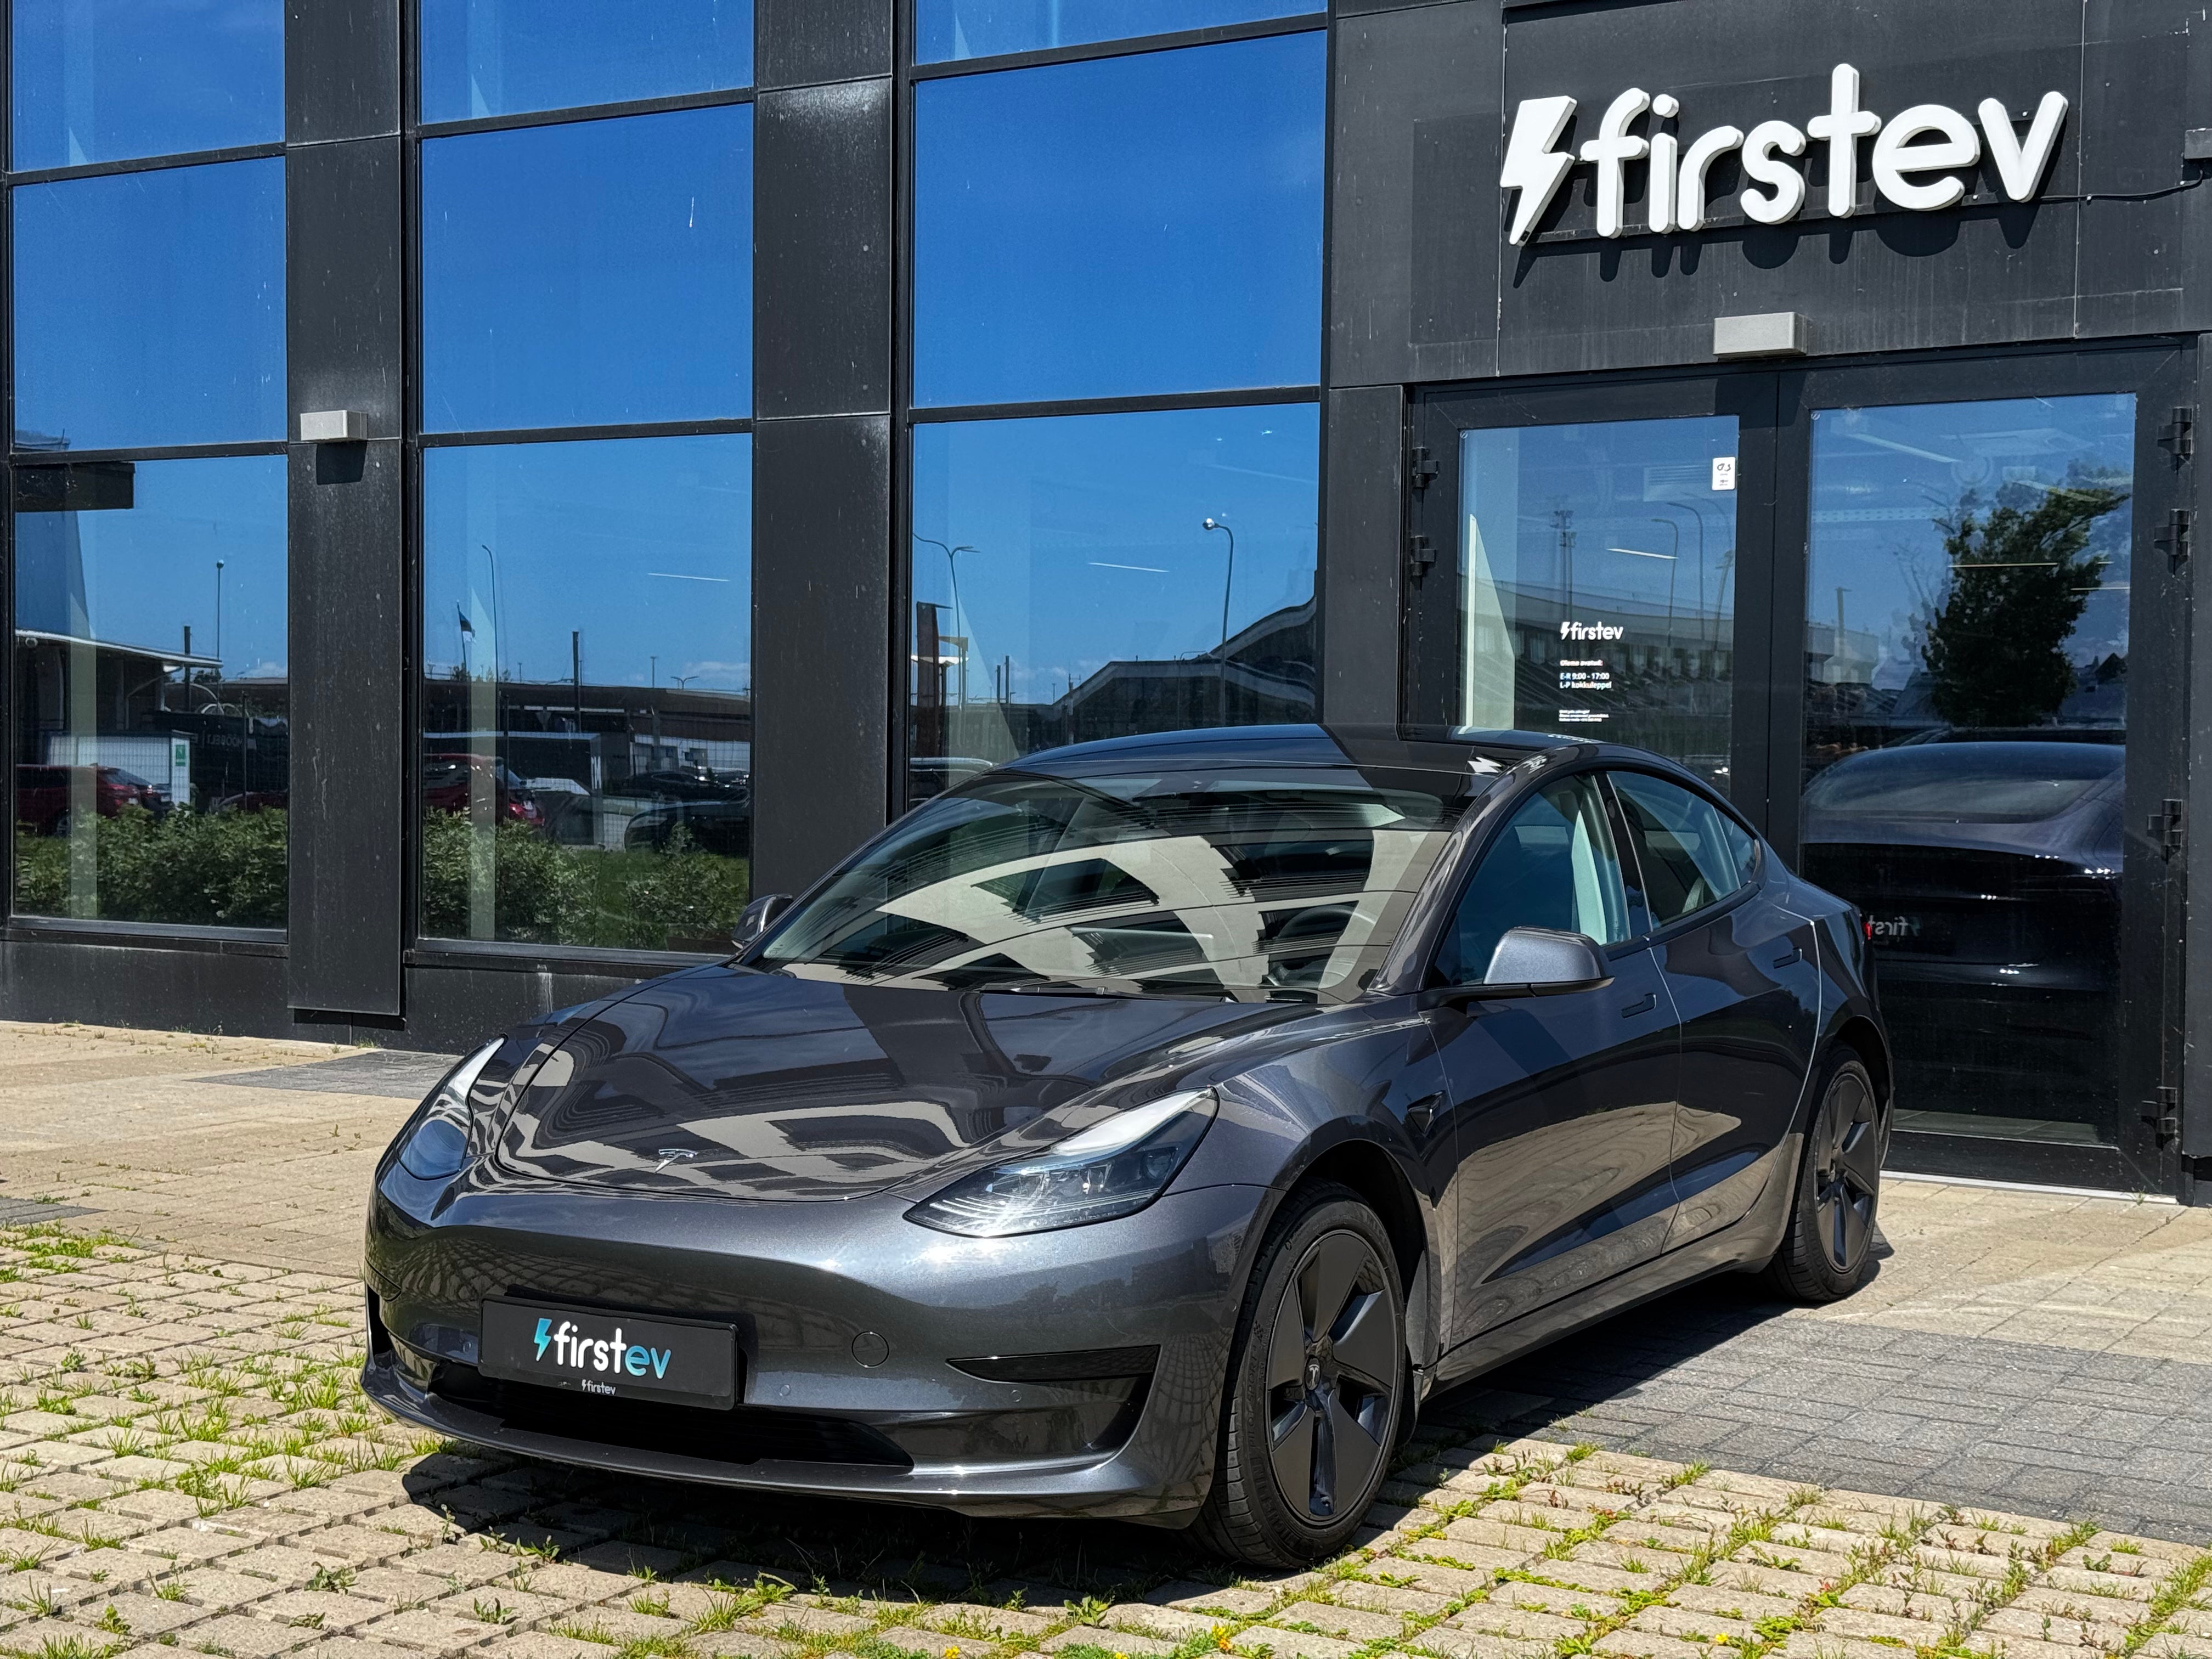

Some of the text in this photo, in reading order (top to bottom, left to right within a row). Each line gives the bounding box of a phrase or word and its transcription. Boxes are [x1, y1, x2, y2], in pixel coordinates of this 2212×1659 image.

[1581, 63, 2069, 238] firstev
[1571, 620, 1623, 640] firstev
[554, 1321, 672, 1379] firstev
[587, 1380, 616, 1395] firstev
